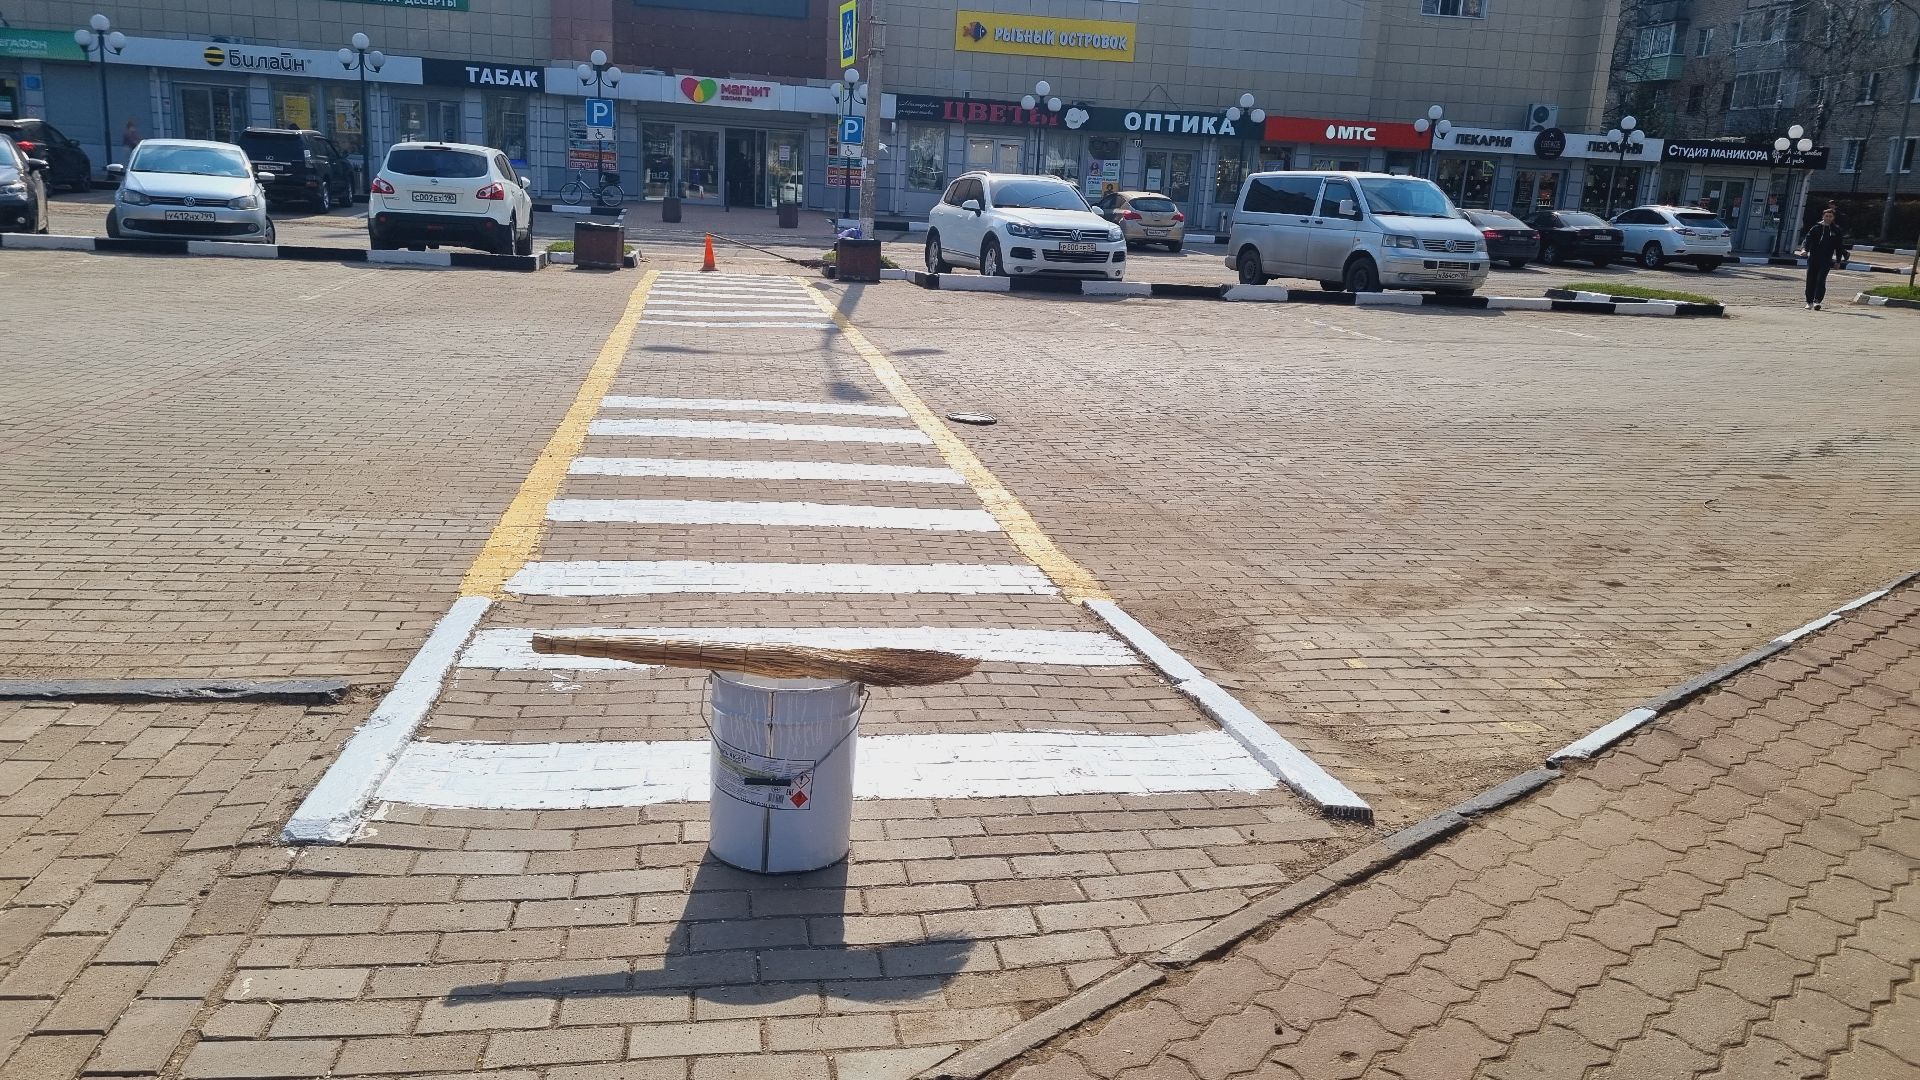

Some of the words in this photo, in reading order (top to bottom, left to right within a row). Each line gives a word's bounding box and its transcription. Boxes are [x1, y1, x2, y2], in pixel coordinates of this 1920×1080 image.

[994, 27, 1056, 45] РЫБНЫЙ
[1059, 32, 1128, 50] ОСТРОВОК
[228, 49, 305, 71] Билайн
[465, 66, 539, 88] ТАБАК
[593, 102, 608, 124] P
[943, 101, 1058, 125] ЦВЕТЫ
[1124, 111, 1236, 136] ОПТИКА
[844, 119, 859, 141] P
[1337, 125, 1377, 141] МТС
[1455, 133, 1513, 147] ПЕКАРНЯ
